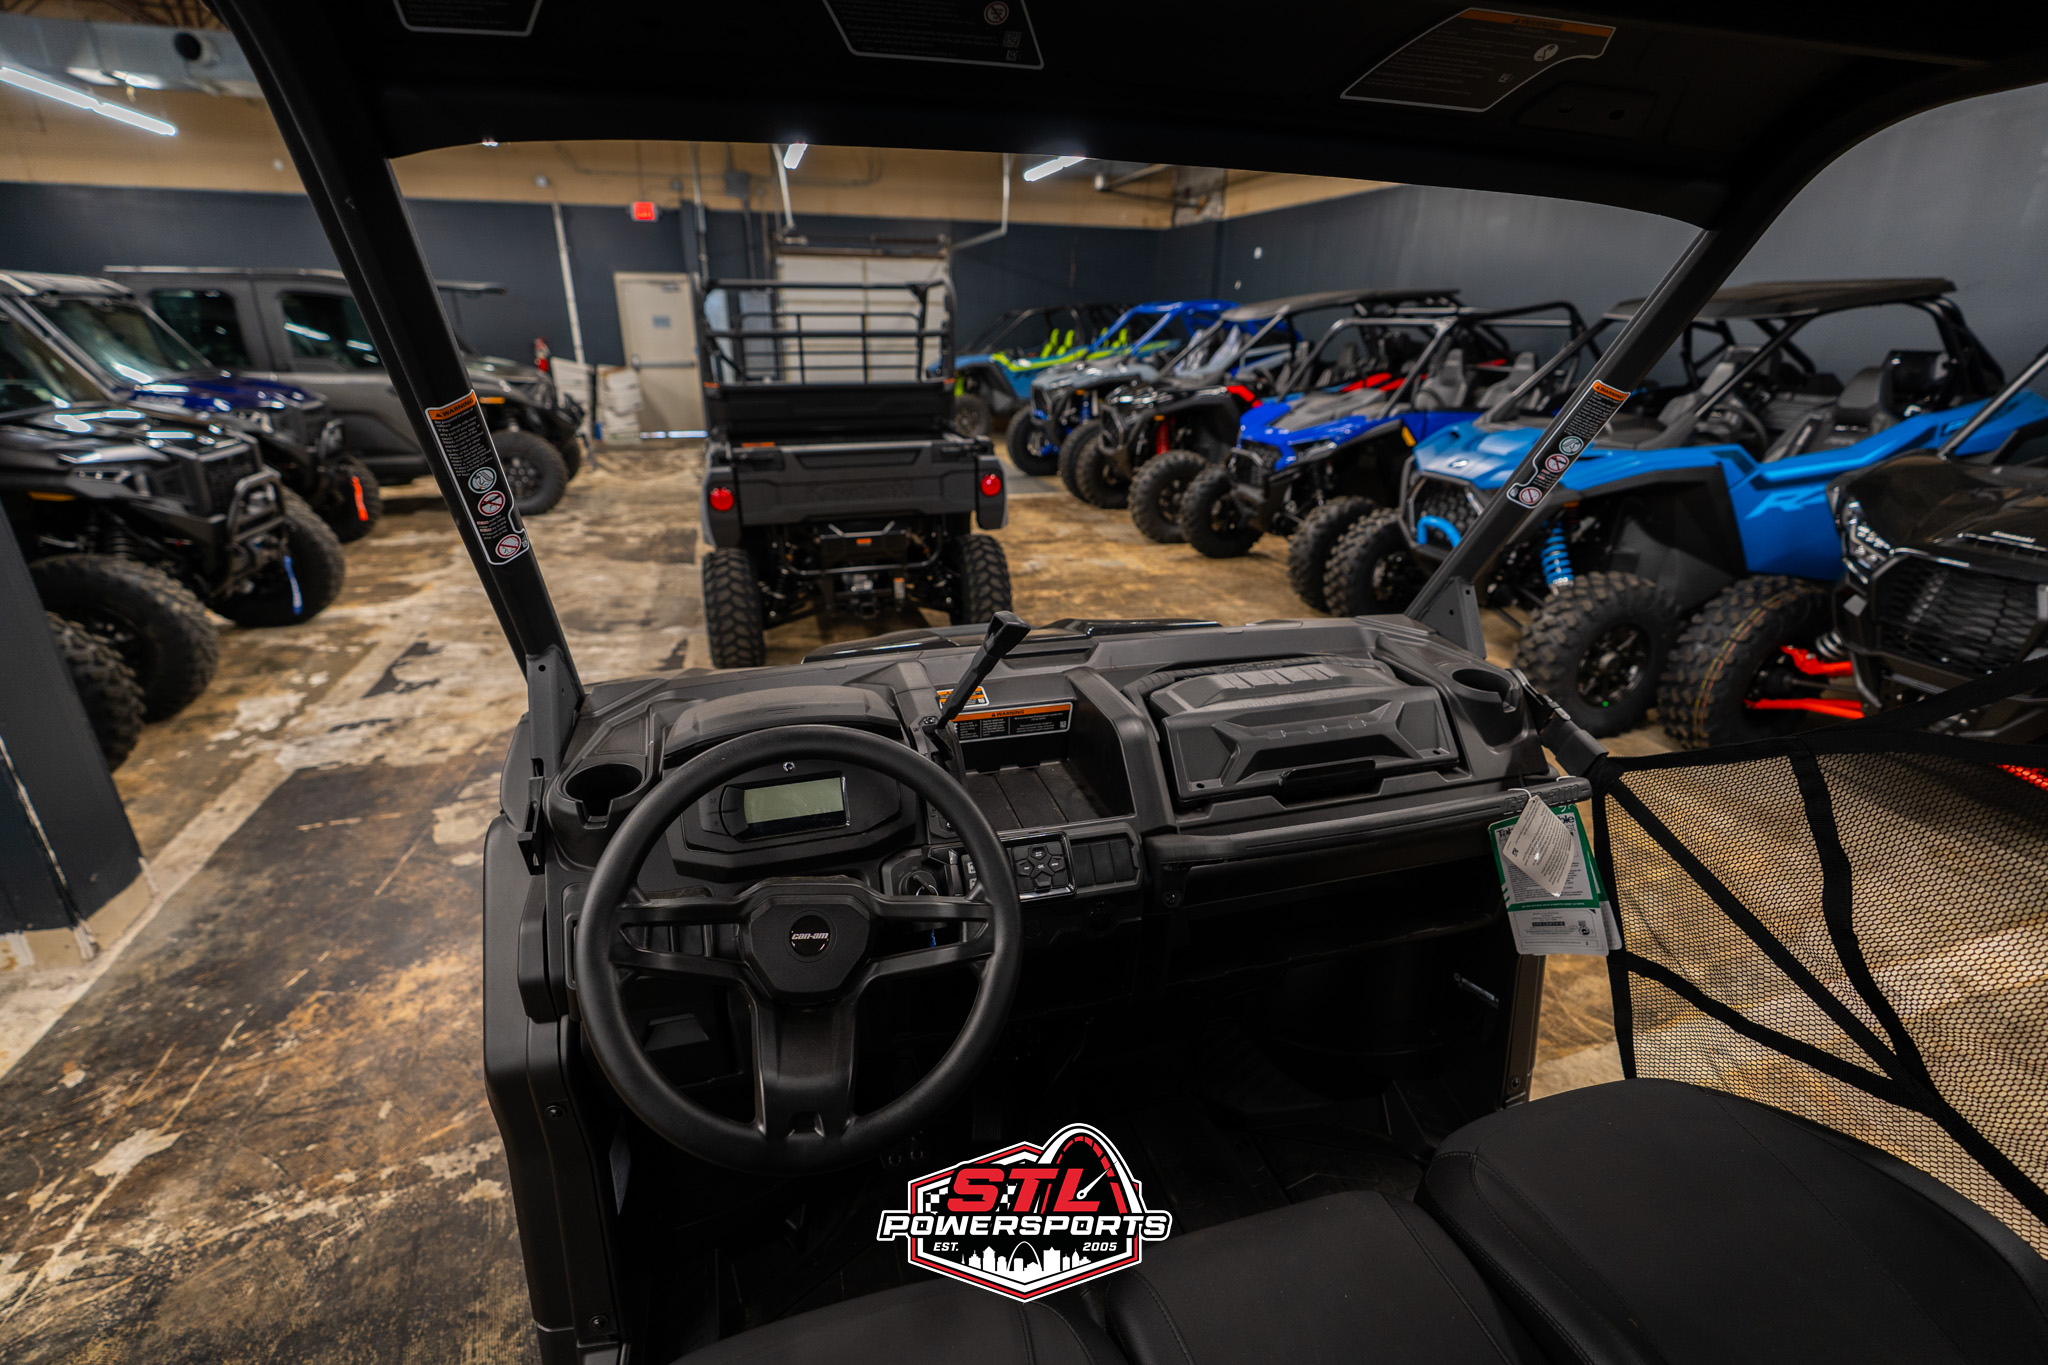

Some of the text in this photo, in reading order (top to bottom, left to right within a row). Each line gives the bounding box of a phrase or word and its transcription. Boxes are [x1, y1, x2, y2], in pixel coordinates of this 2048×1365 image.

[442, 398, 474, 417] WARNING
[996, 709, 1025, 717] WARNING
[791, 932, 829, 940] can-am
